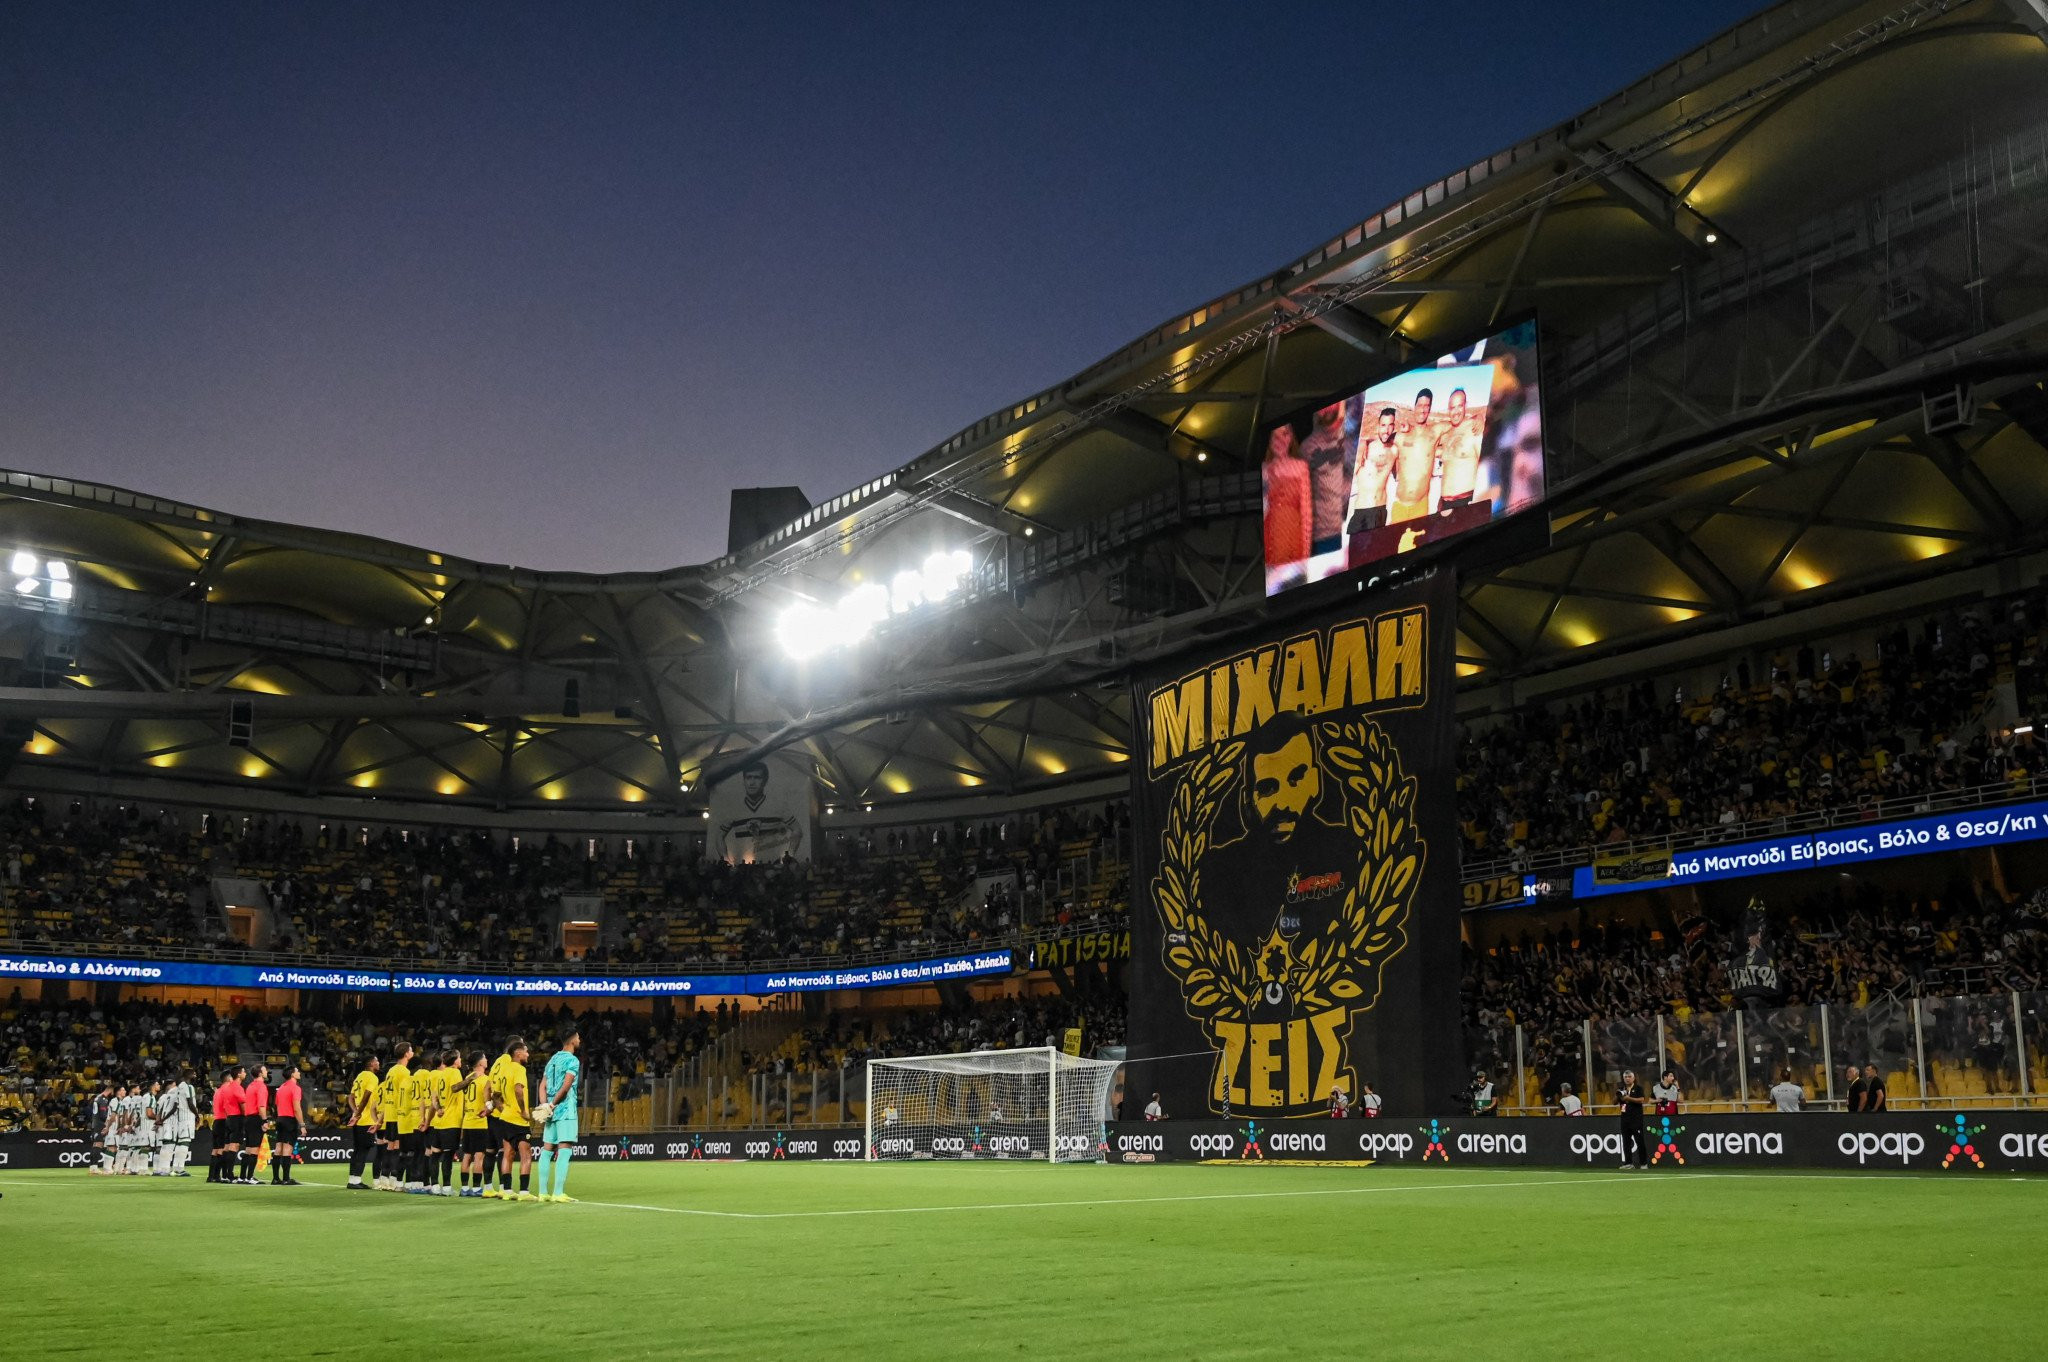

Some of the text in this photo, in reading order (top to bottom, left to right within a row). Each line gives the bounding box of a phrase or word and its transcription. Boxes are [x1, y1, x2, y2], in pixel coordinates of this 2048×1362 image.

[1152, 613, 1422, 769] ΜΙΧΑΛΗ
[1667, 859, 1700, 877] Από
[1704, 847, 1786, 872] Μαντούδι
[1791, 838, 1874, 861] Εύβοιας,
[1879, 829, 1931, 849] Βόλο
[1936, 825, 1950, 841] &
[1956, 813, 2037, 838] Θεσ/κη
[1036, 932, 1131, 967] PATISSIA
[0, 960, 161, 978] Σκόπελο & Αλόννησο
[767, 978, 786, 988] Από
[789, 975, 834, 987] Μαντούδι
[872, 970, 892, 982] Βόλο
[893, 968, 900, 979] &
[258, 972, 691, 993] Από Μαντούδι Εύβοιας, Βόλο & Θεσ/κη για Σκιάθο, Σκόπελο & Αλόννησο
[1214, 1005, 1350, 1107] ΖΕΙΣ
[598, 1143, 655, 1159] opap arena
[666, 1141, 731, 1158] opap arena
[745, 1140, 818, 1158] opap arena
[833, 1139, 914, 1158] opap arena
[990, 1137, 1028, 1151] arena
[1118, 1135, 1163, 1151] arena
[1190, 1134, 1326, 1158] opap arena
[1360, 1133, 1527, 1159] opap arena
[1695, 1133, 1783, 1155] arena
[1838, 1133, 1925, 1165] opap
